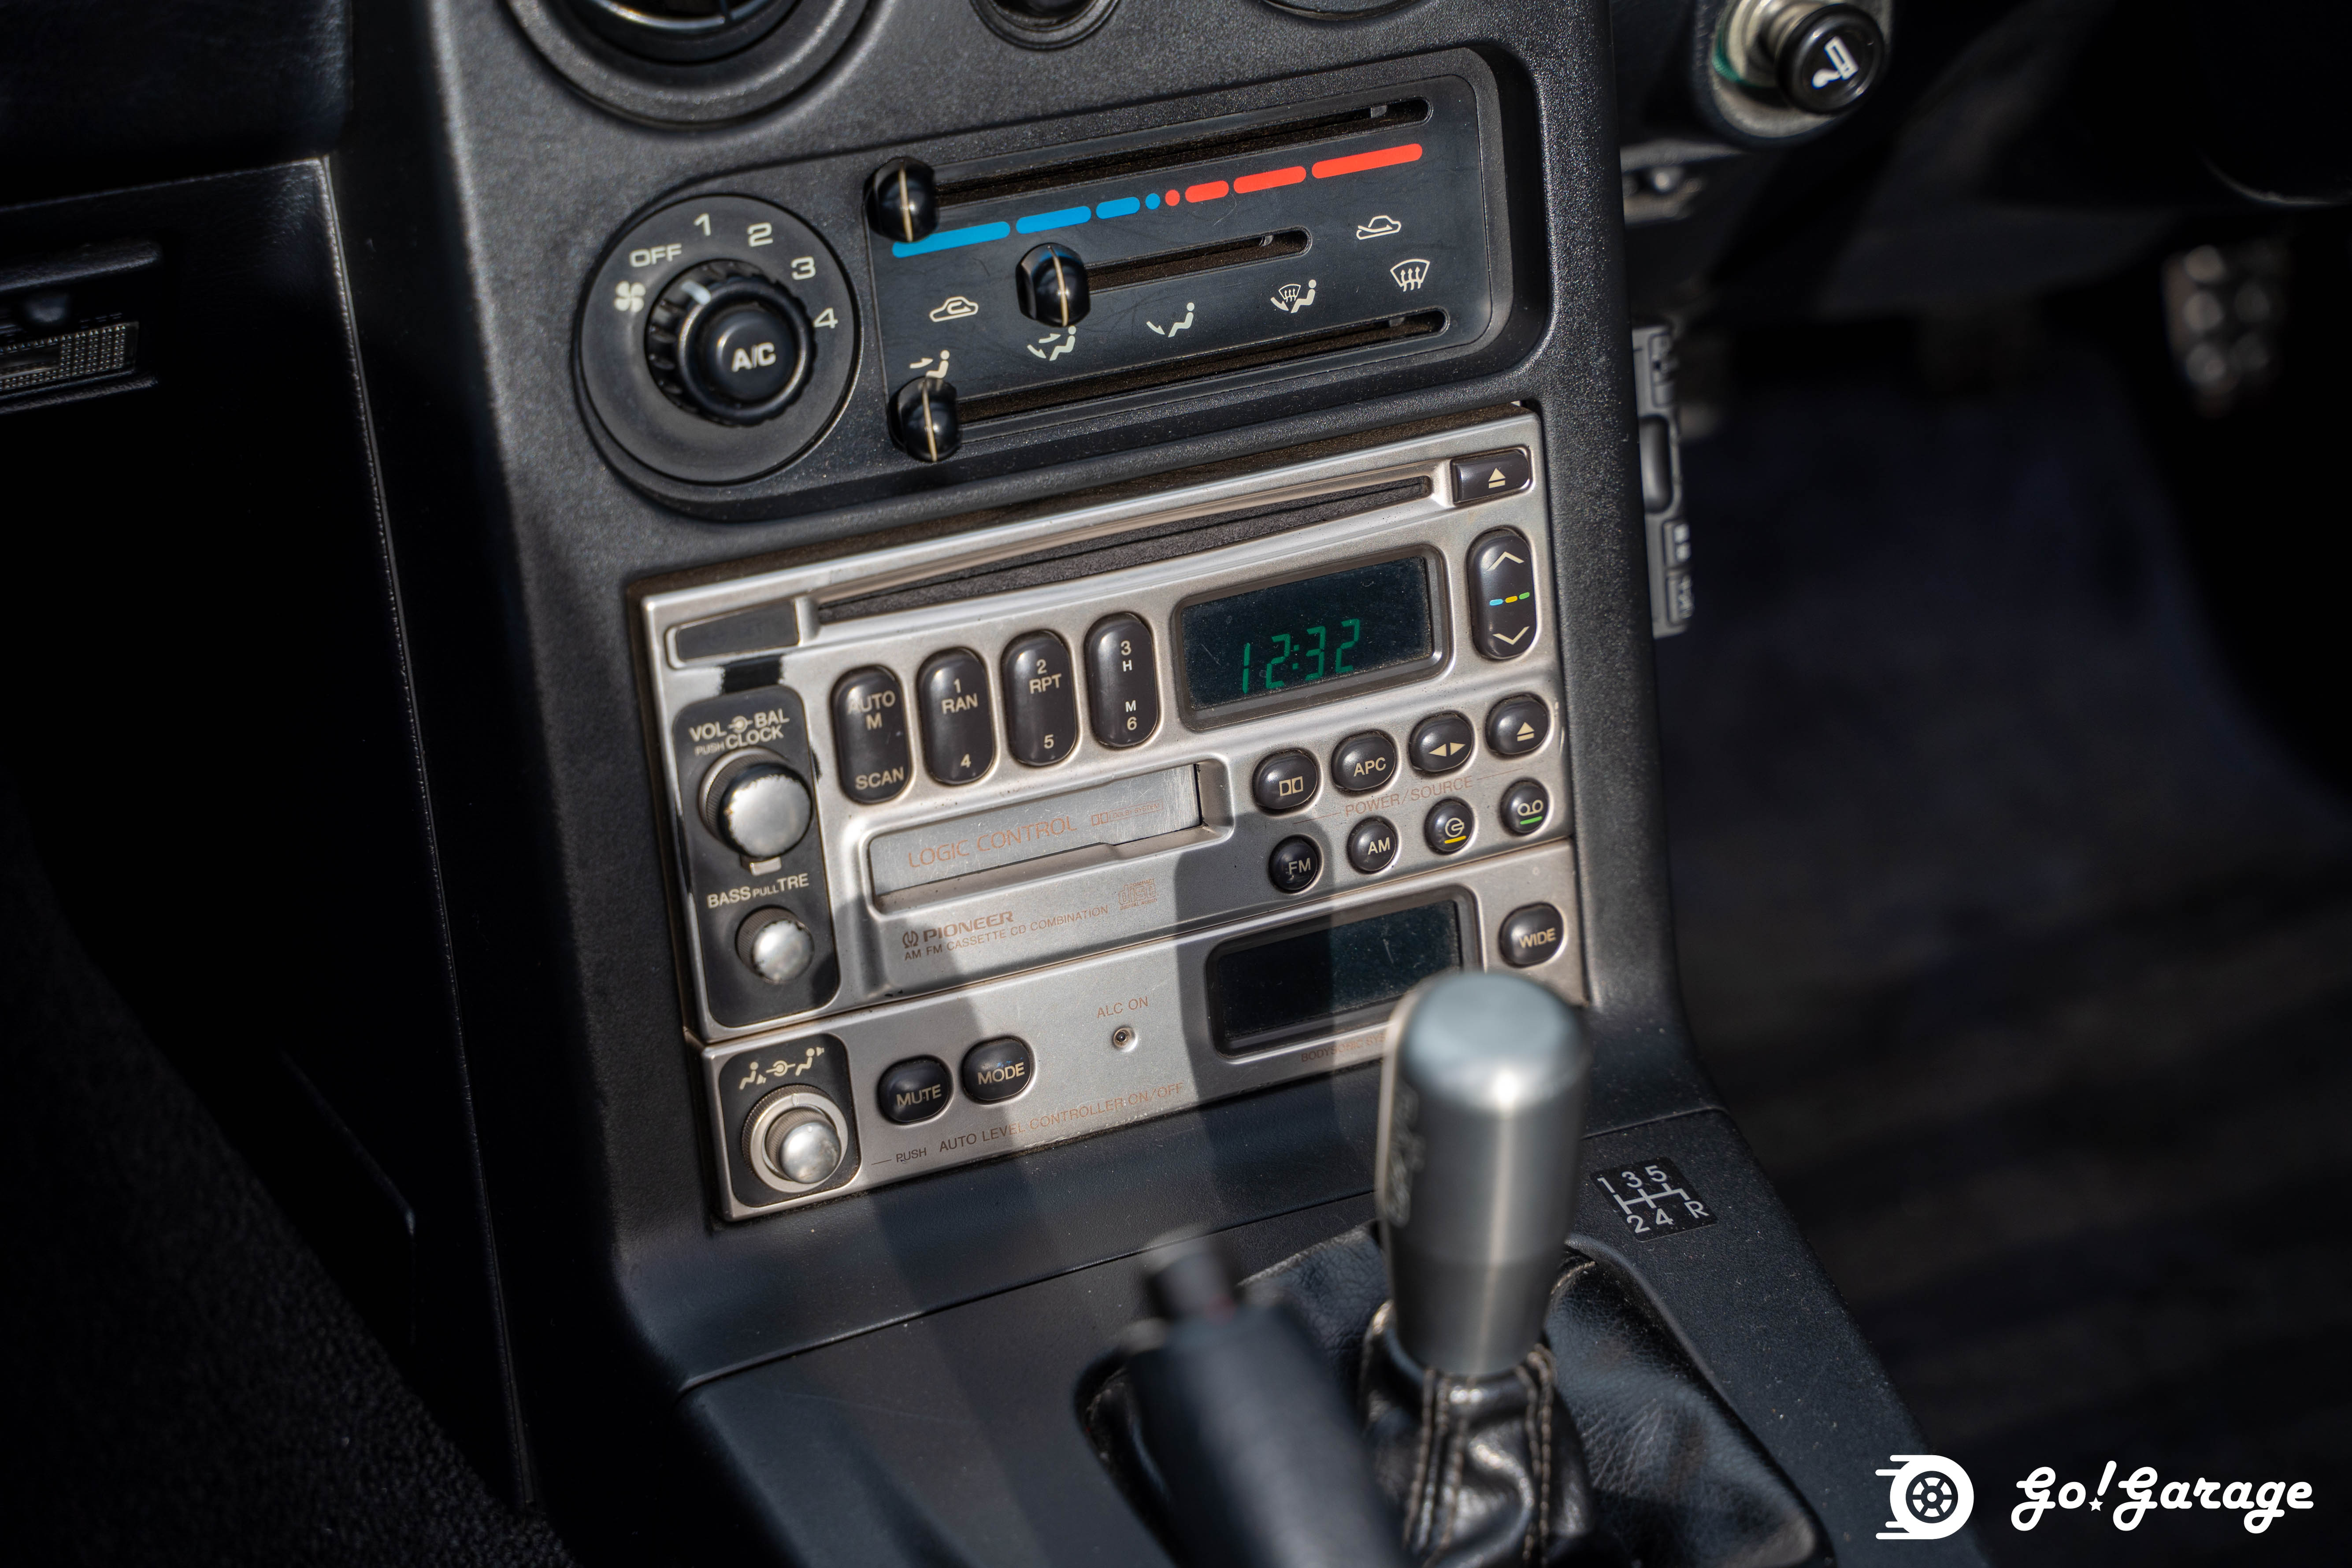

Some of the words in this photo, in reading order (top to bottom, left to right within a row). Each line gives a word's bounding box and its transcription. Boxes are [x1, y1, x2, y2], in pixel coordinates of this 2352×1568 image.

[694, 213, 711, 236] 1
[748, 222, 773, 247] 2
[630, 244, 682, 267] OFF
[791, 256, 816, 280] 3
[813, 308, 838, 329] 4
[731, 342, 776, 372] A/C
[1120, 640, 1132, 656] 3
[1243, 618, 1360, 694] 12:32
[1036, 660, 1047, 675] 2
[1122, 659, 1133, 673] H
[953, 678, 961, 693] 1
[1029, 674, 1062, 695] RPT
[846, 690, 896, 715] AUTO
[941, 693, 979, 714] RAN
[1125, 700, 1137, 712] M
[689, 722, 727, 743] VOL
[753, 708, 790, 727] BAL
[866, 713, 883, 730] M
[1126, 716, 1137, 731] 6
[694, 741, 725, 756] PUSH
[725, 725, 784, 749] CLOCK
[1043, 734, 1054, 749] 5
[960, 753, 971, 768] 4
[1353, 756, 1386, 778] APC
[855, 766, 905, 791] SCAN
[1344, 775, 1473, 818] POWER/SOURCE
[1134, 803, 1161, 814] SYSTEM
[908, 839, 969, 867] LOGIC
[976, 816, 1078, 852] CONTROL
[1367, 837, 1391, 856] AM
[1288, 857, 1311, 875] FM
[707, 886, 751, 909] BASS
[752, 885, 779, 898] PULL
[776, 873, 809, 892] TRE
[904, 949, 921, 961] AM
[927, 943, 942, 956] FM
[947, 930, 1007, 951] CASSETTE
[1010, 925, 1027, 936] CD
[1031, 904, 1109, 931] COMBINATION
[923, 911, 1014, 942] PIONEER
[1518, 927, 1556, 949] WIDE
[1097, 1002, 1122, 1019] ALC
[1128, 996, 1148, 1011] ON
[977, 1062, 1026, 1085] MODE
[896, 1084, 942, 1108] MUTE
[896, 1147, 927, 1163] PUSH
[939, 1132, 977, 1153] AUTO
[982, 1122, 1026, 1142] LEVEL
[1029, 1097, 1124, 1130] CONTROLLER
[1127, 1082, 1183, 1107] ON/OFF
[1597, 1177, 1615, 1193] 1
[1621, 1171, 1642, 1188] 3
[1644, 1165, 1667, 1182] 5
[1626, 1215, 1650, 1233] 2
[1656, 1208, 1674, 1225] 4
[1684, 1201, 1710, 1219] R
